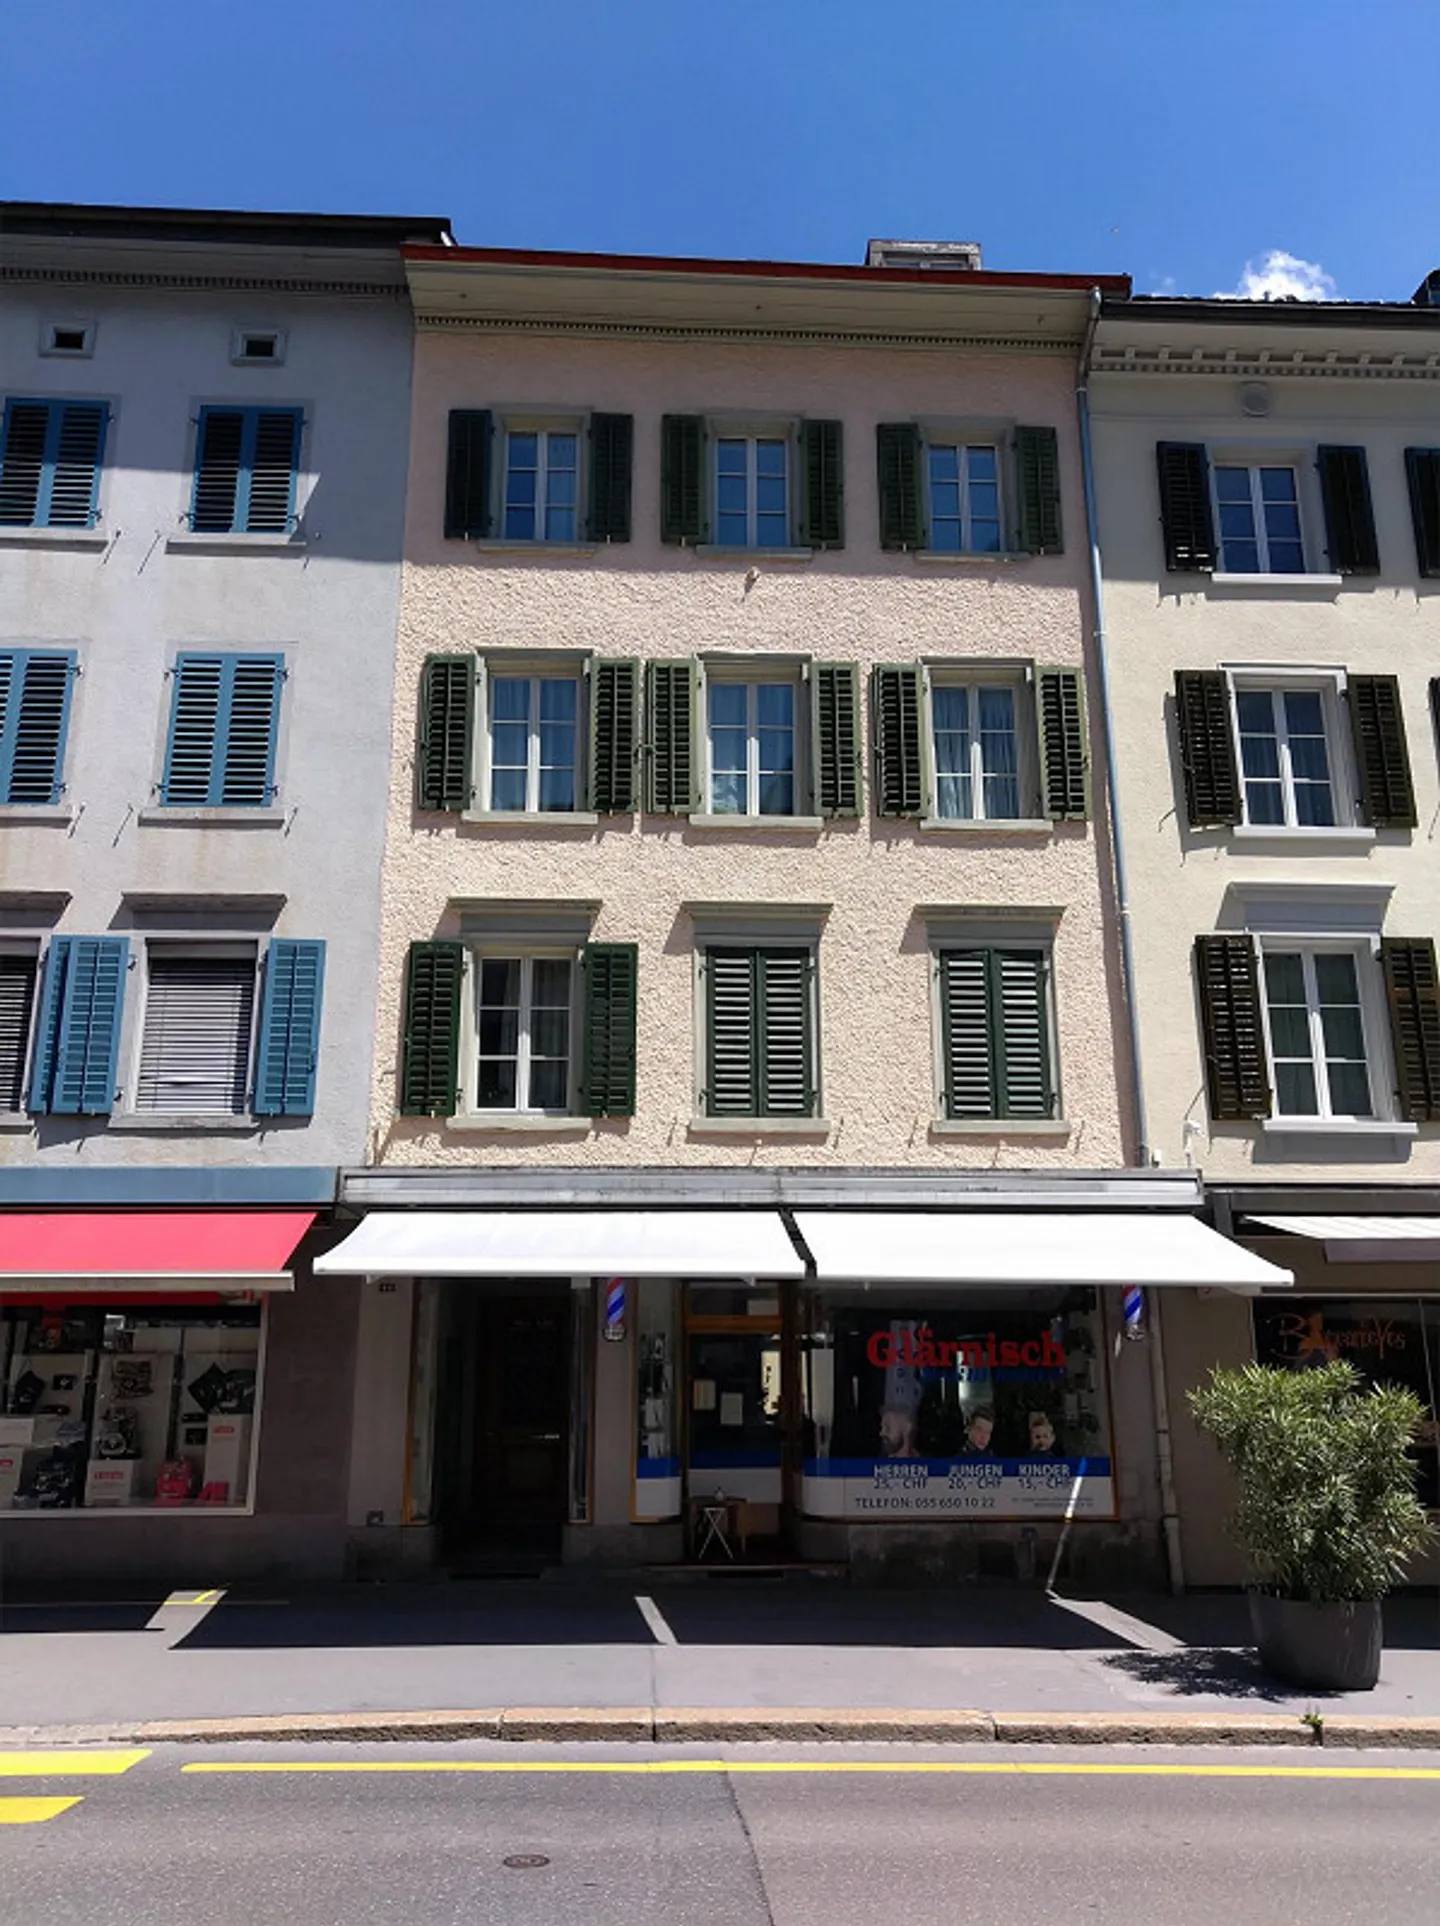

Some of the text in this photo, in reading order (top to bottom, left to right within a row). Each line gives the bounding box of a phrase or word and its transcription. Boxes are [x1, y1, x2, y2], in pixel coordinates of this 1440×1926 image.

[866, 1326, 1066, 1368] Glärnisch
[874, 1464, 1070, 1478] HERREN JUNGEN KINDER
[903, 1478, 927, 1489] CHF
[977, 1478, 1002, 1489] CHF
[855, 1497, 912, 1509] TELEFON:
[965, 1497, 978, 1509] 10
[981, 1497, 995, 1508] 22
